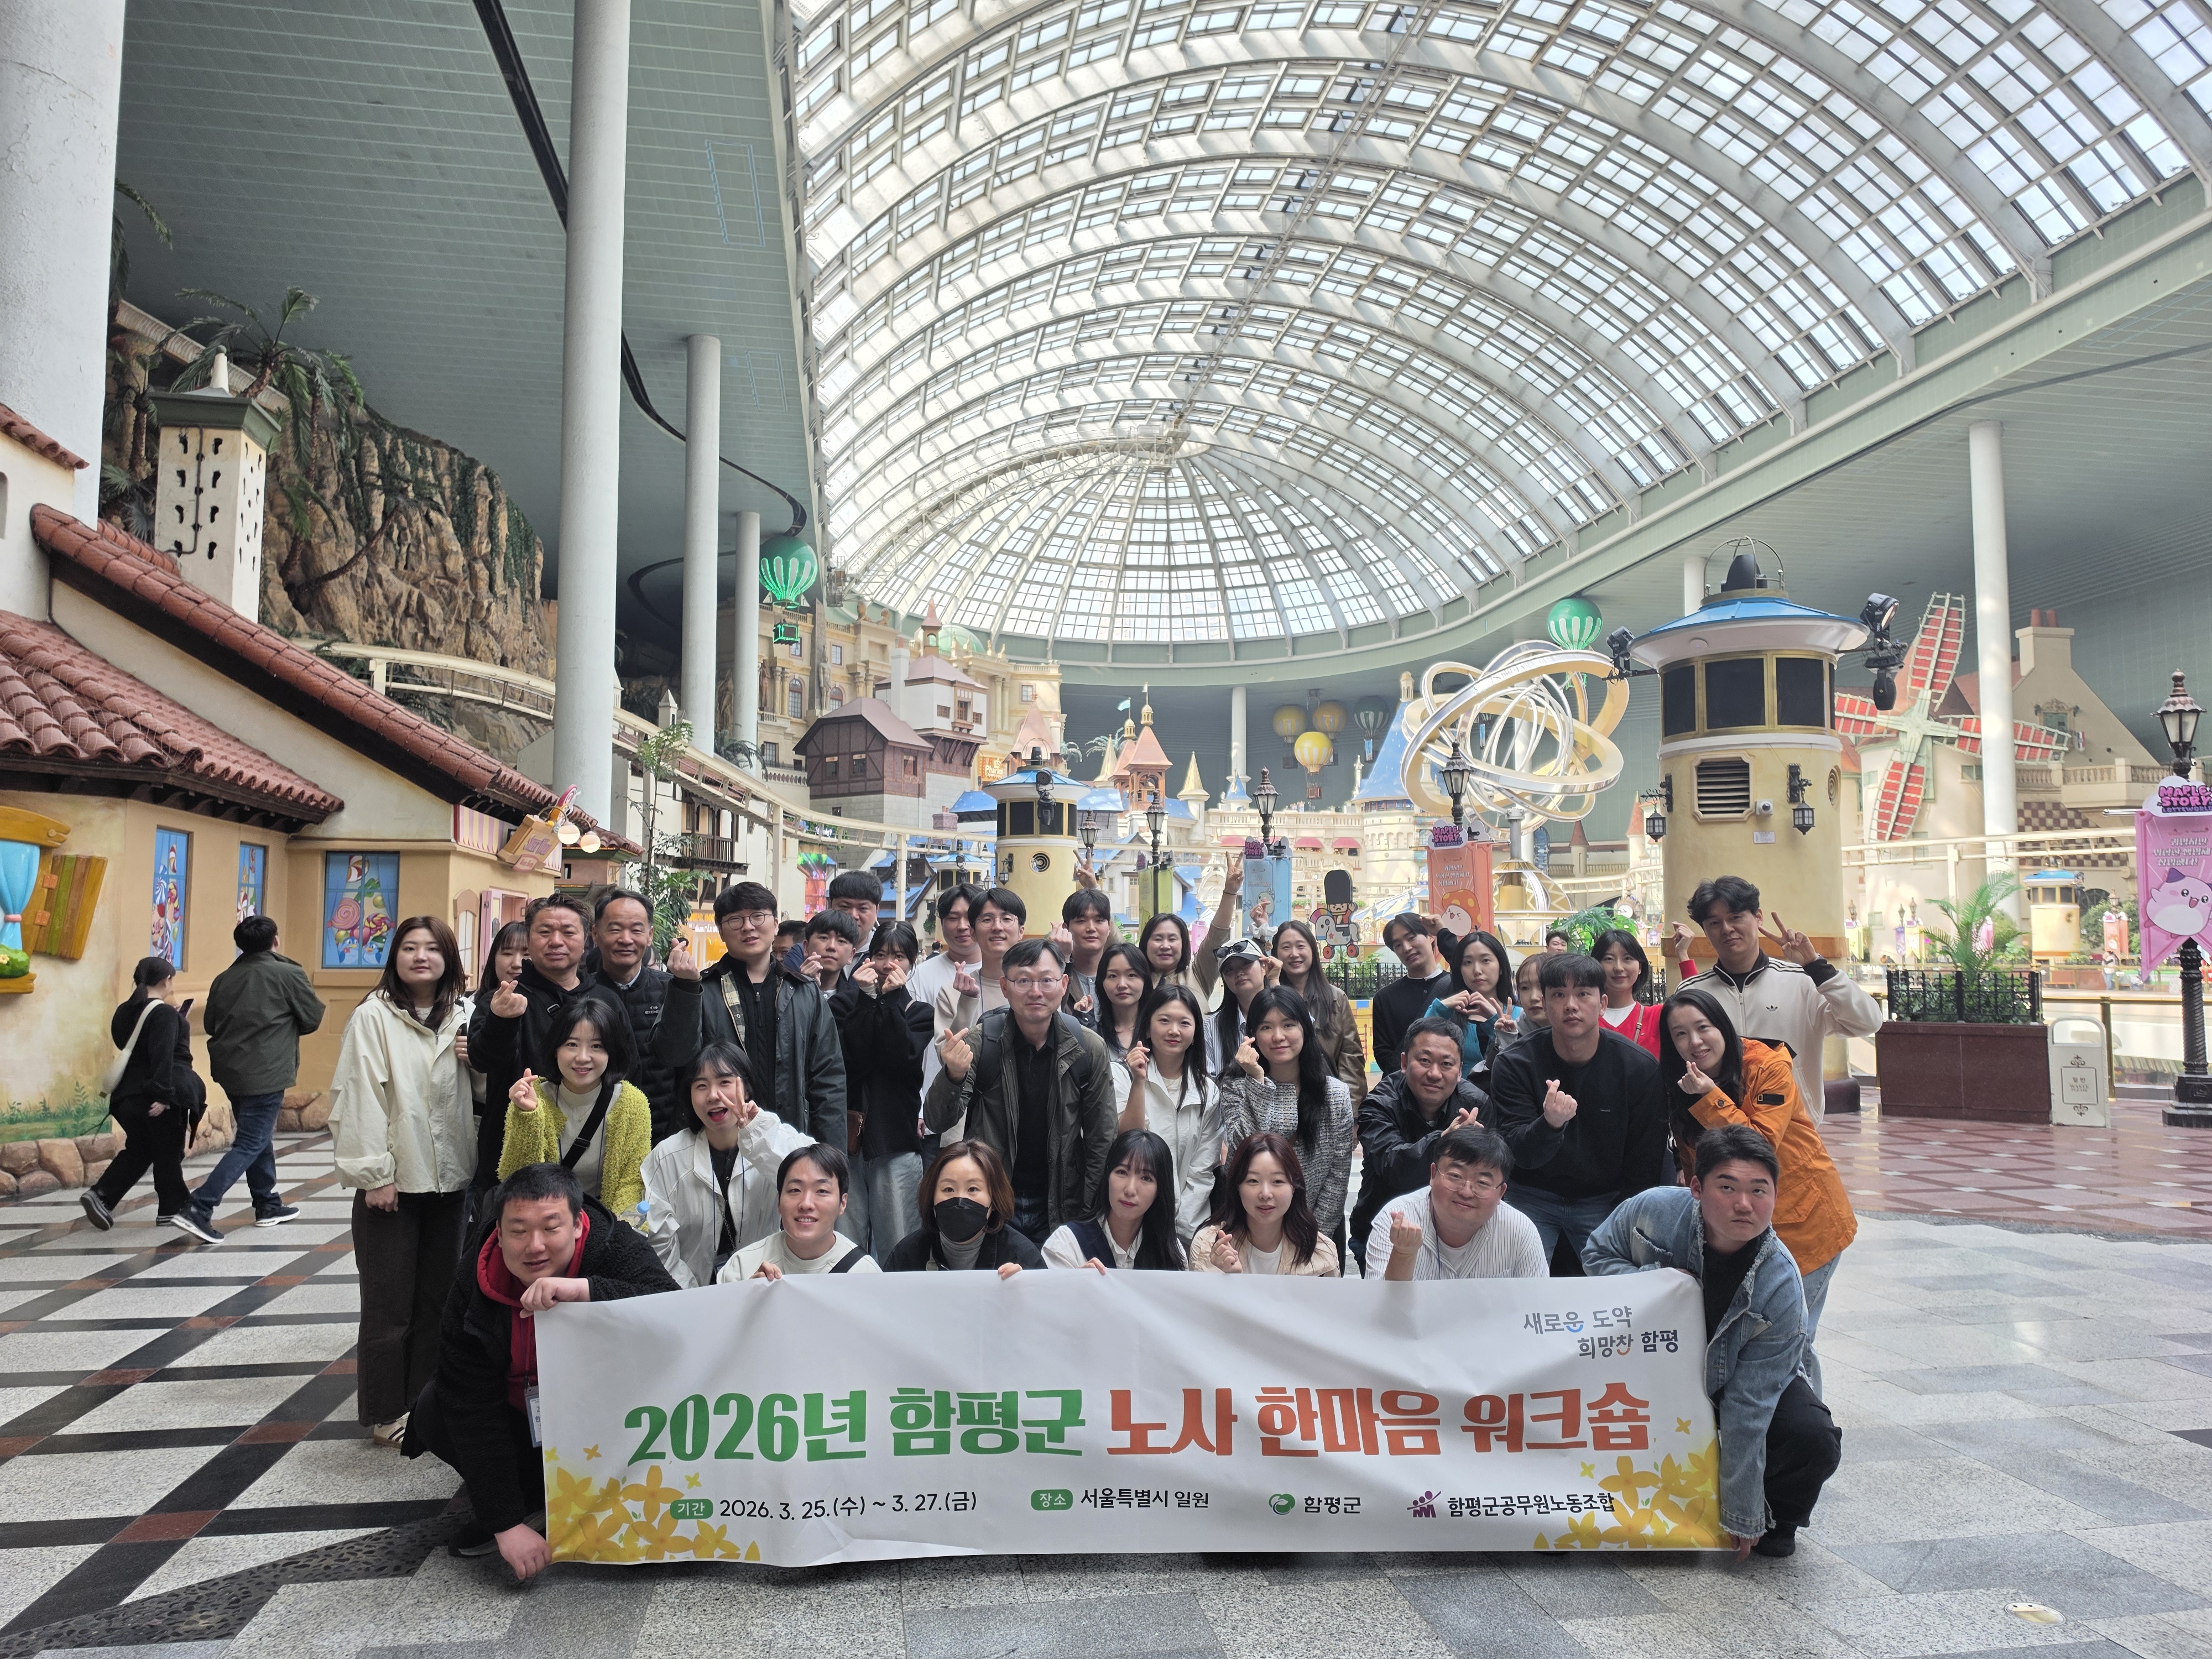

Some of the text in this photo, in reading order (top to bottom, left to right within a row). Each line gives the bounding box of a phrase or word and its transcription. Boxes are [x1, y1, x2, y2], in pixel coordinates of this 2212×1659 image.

[2159, 785, 2211, 797] MAPLE
[2161, 796, 2211, 807] STORY
[1433, 826, 1459, 836] MAPLE
[1434, 834, 1460, 842] STORY
[1245, 842, 1261, 850] MAPLE
[1524, 1306, 1632, 1334] 새로운 도약
[1577, 1329, 1678, 1359] 희망찬 함평
[624, 1382, 1651, 1467] 2026년 함평군 노사 한마음 워크숍
[1039, 1488, 1209, 1509] 장소 서울특별시 일원
[1304, 1496, 1361, 1514] 함평군
[1448, 1493, 1616, 1518] 함평군공무원노동조합
[677, 1502, 706, 1516] 기간
[720, 1499, 774, 1519] 2026.
[779, 1502, 795, 1521] 3.
[892, 1496, 908, 1512] 3.
